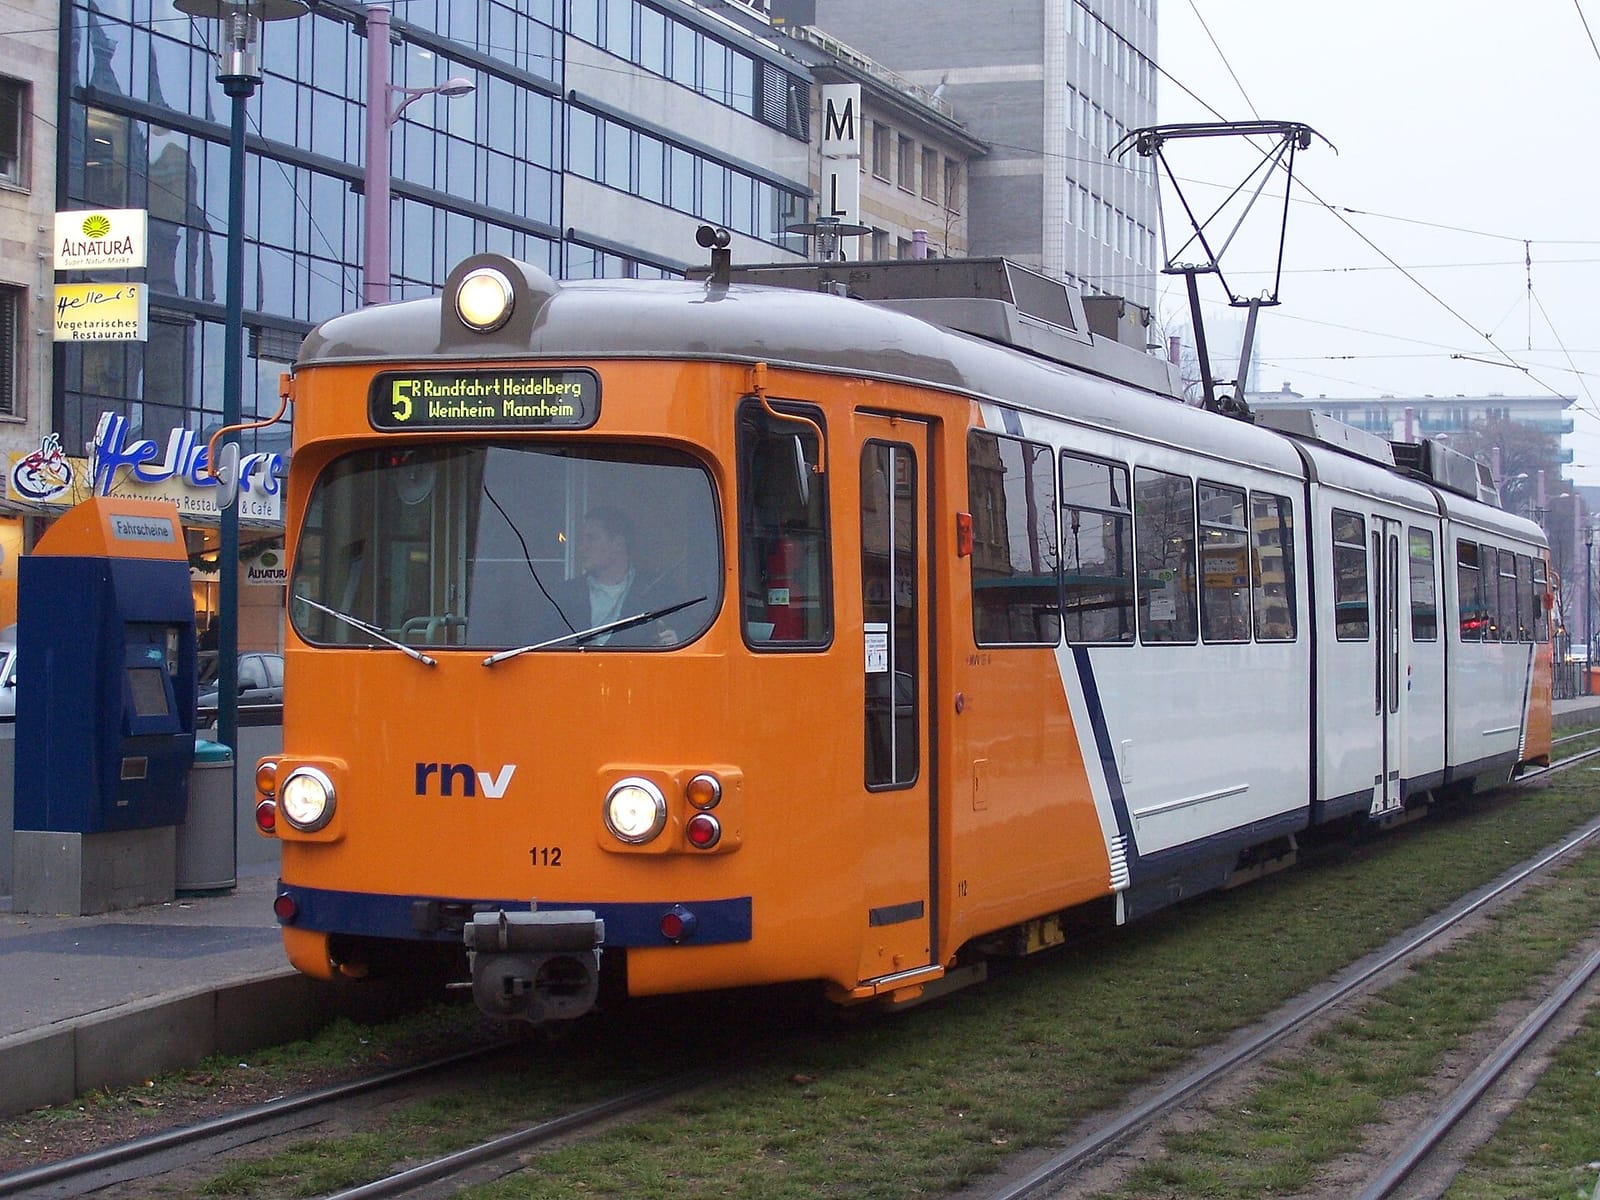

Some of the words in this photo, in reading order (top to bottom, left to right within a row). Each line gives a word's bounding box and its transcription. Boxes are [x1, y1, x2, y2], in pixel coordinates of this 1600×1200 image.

[62, 236, 133, 256] ALNATURA
[57, 320, 137, 330] Vegetarisches
[72, 330, 138, 340] Restaurant
[391, 380, 413, 422] 5
[423, 379, 501, 397] Rundfahrt
[503, 378, 581, 397] Heidelberg
[429, 399, 495, 418] Weinheim
[503, 398, 573, 417] Mannheim
[241, 501, 248, 514] &
[251, 501, 272, 516] Café
[116, 520, 169, 537] Fahrscheine
[415, 762, 517, 799] rnv
[529, 847, 562, 866] 112
[958, 880, 968, 897] 112
